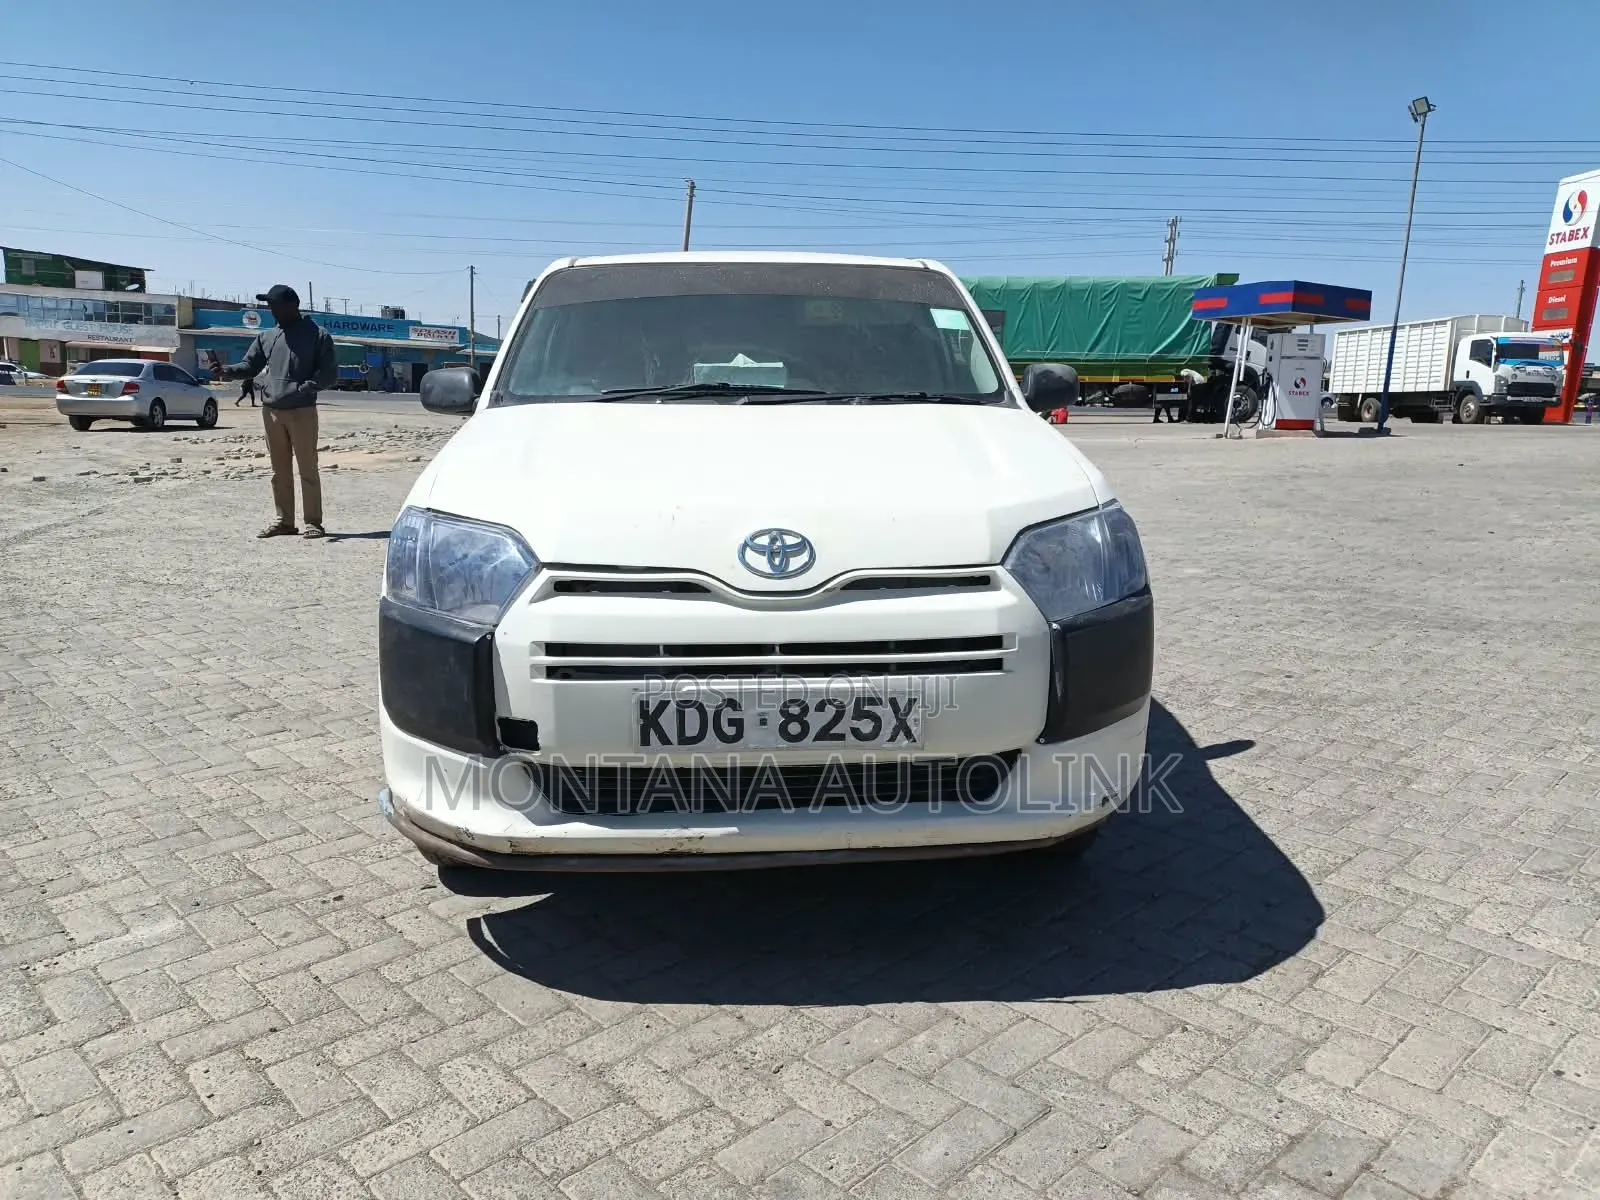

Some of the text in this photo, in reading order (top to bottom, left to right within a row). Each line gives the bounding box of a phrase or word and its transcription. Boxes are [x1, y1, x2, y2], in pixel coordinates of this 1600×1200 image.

[1549, 226, 1590, 246] STABEX
[1550, 256, 1578, 267] Premium
[1548, 294, 1567, 304] Diesel
[323, 320, 396, 333] HARDWARE
[638, 696, 918, 747] KDG 825X
